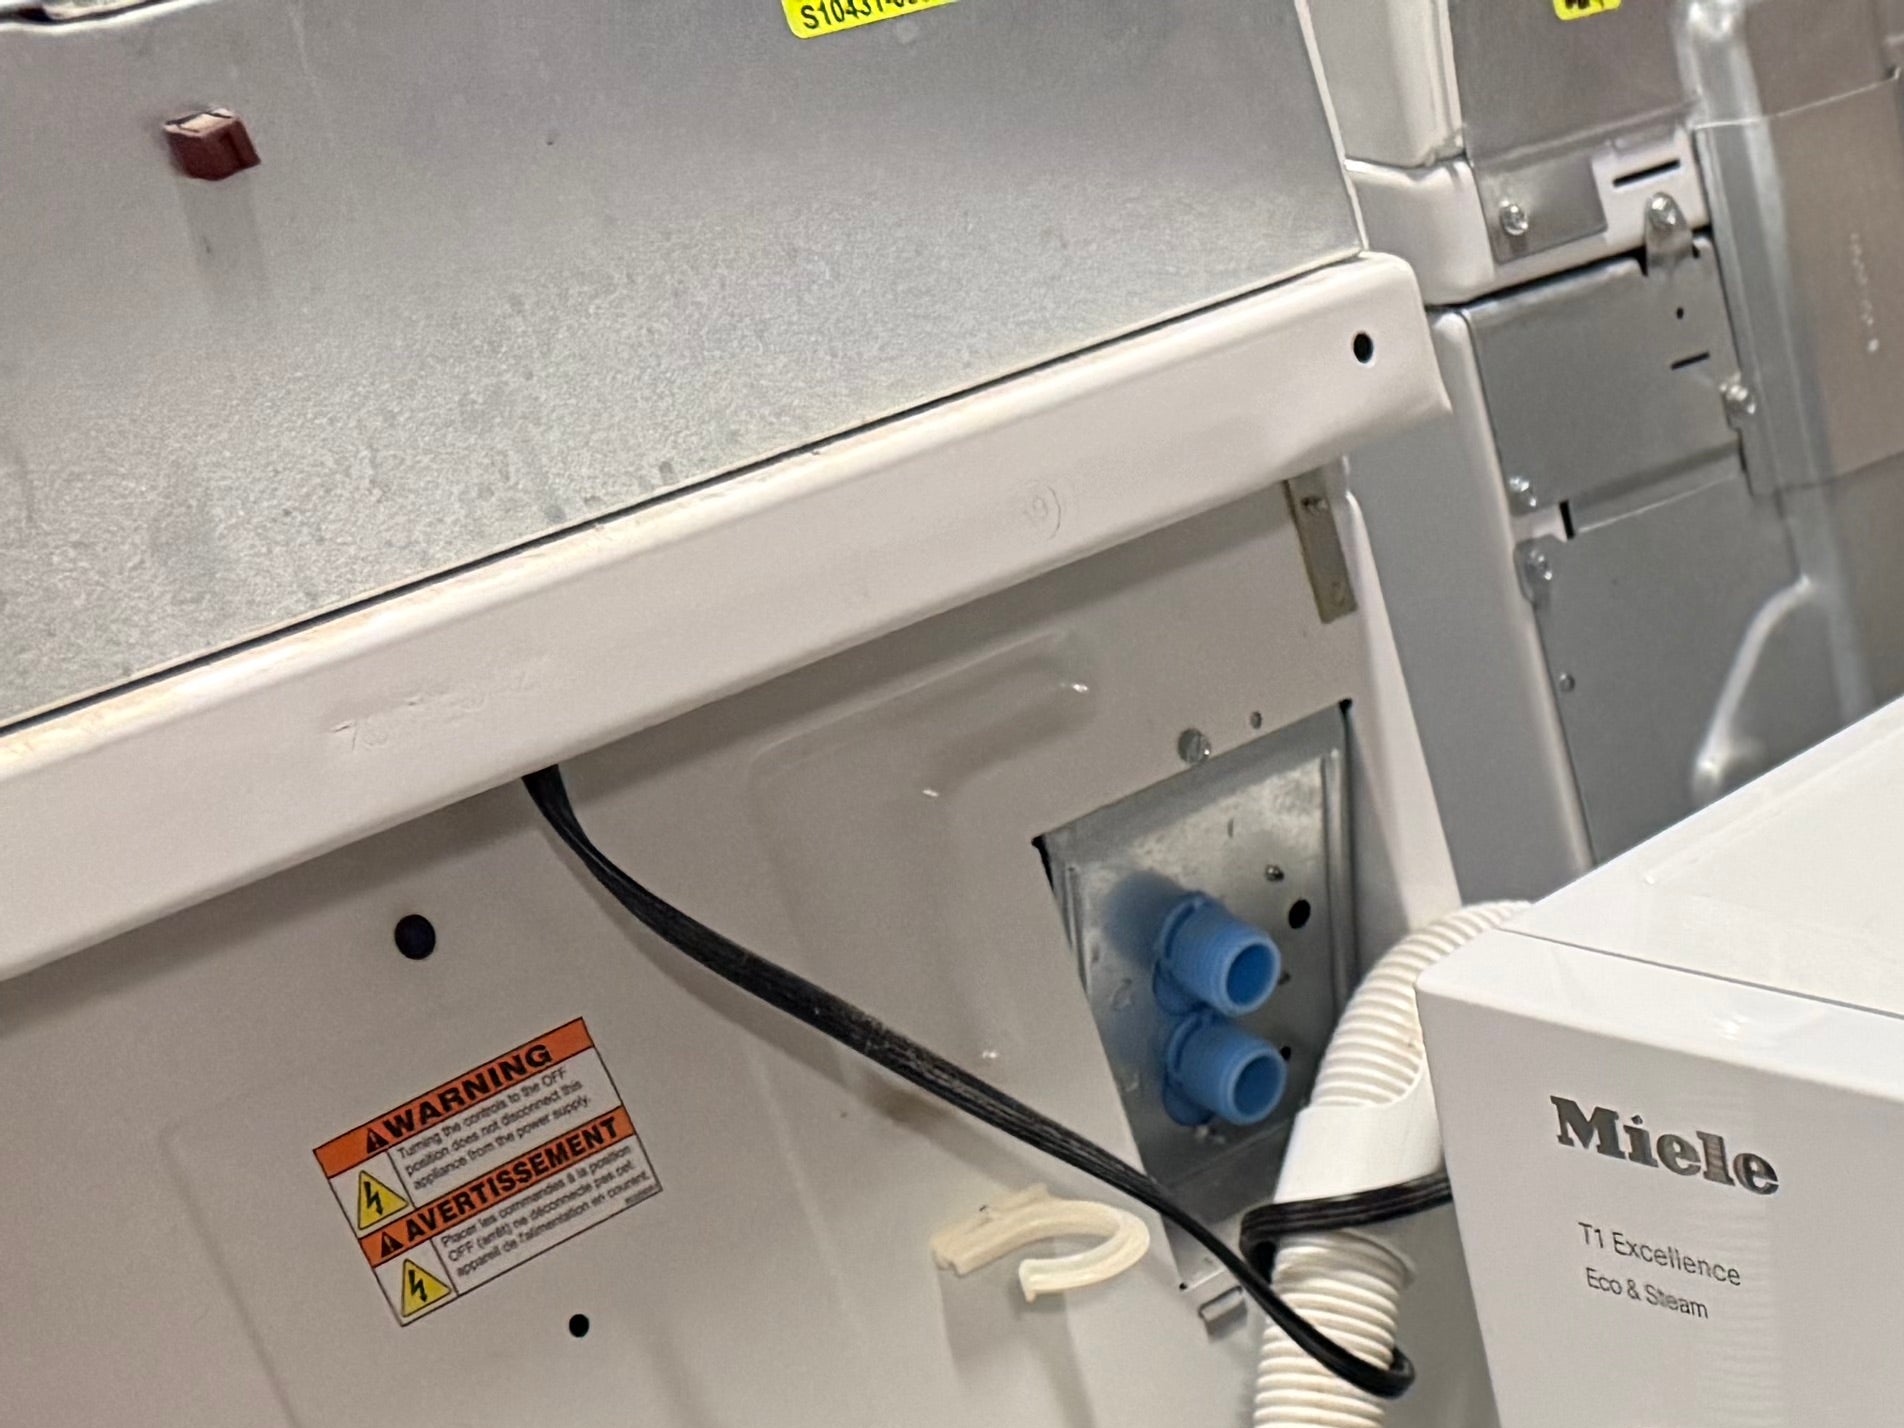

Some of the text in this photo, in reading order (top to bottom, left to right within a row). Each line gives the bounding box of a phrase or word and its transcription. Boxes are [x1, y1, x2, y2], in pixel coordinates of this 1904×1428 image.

[382, 1043, 553, 1142] WARNING
[397, 1066, 567, 1162] Turning the controls to the OFF
[450, 1129, 480, 1151] does
[480, 1120, 500, 1136] not
[499, 1088, 561, 1126] disconnect
[560, 1078, 582, 1096] this
[466, 1139, 495, 1160] from
[494, 1130, 515, 1148] the
[515, 1113, 552, 1139] power
[1550, 1095, 1779, 1195] Miele
[405, 1117, 622, 1242] AVERTISSEMENT
[447, 1241, 475, 1262] OFF
[512, 1215, 529, 1229] ne
[1578, 1222, 1741, 1286] T1 Excellence
[1586, 1268, 1709, 1319] Eco & Steam
